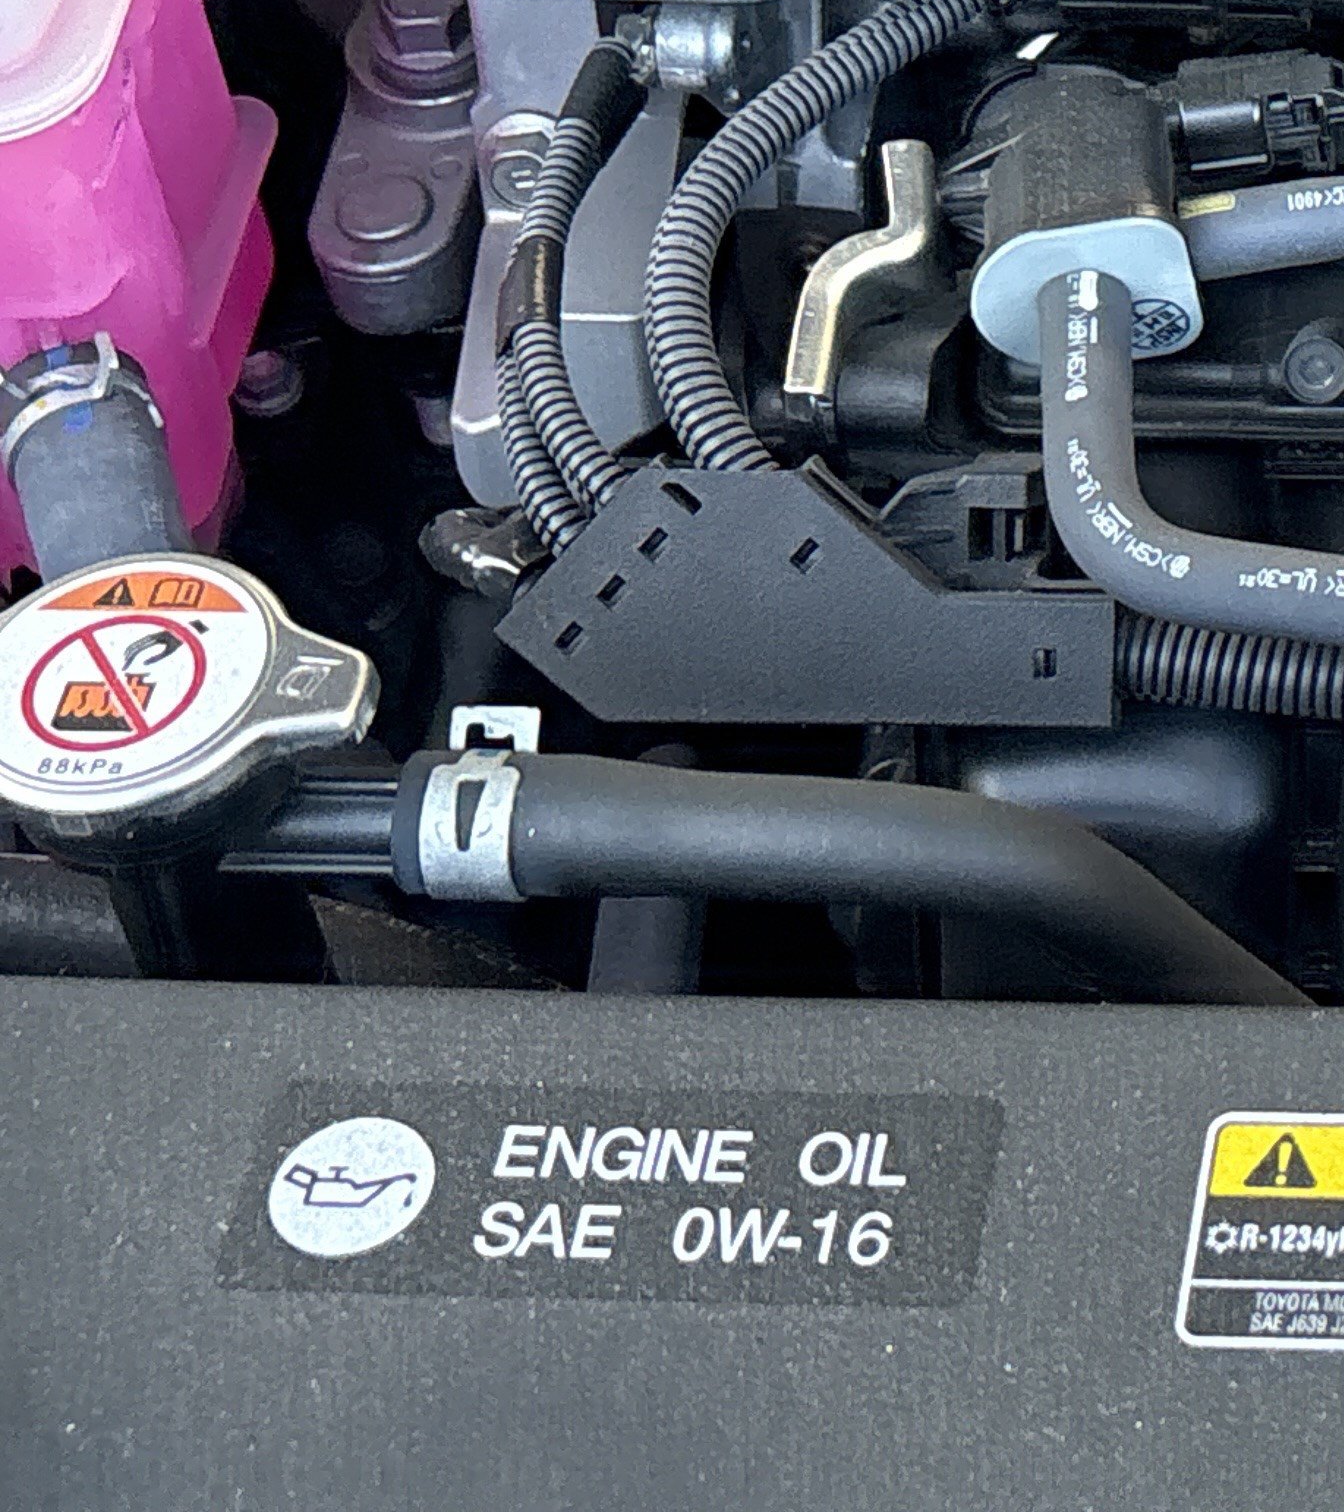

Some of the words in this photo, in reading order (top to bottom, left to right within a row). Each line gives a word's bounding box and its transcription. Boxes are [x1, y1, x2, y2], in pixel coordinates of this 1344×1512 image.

[37, 757, 122, 776] 88kPa
[493, 1124, 754, 1184] ENGINE
[798, 1131, 907, 1187] OIL
[471, 1202, 622, 1260] SAE
[673, 1207, 894, 1268] 0W-16
[1254, 1293, 1320, 1312] TOYOTA
[1249, 1315, 1283, 1332] SAE
[1286, 1316, 1327, 1334] J639
